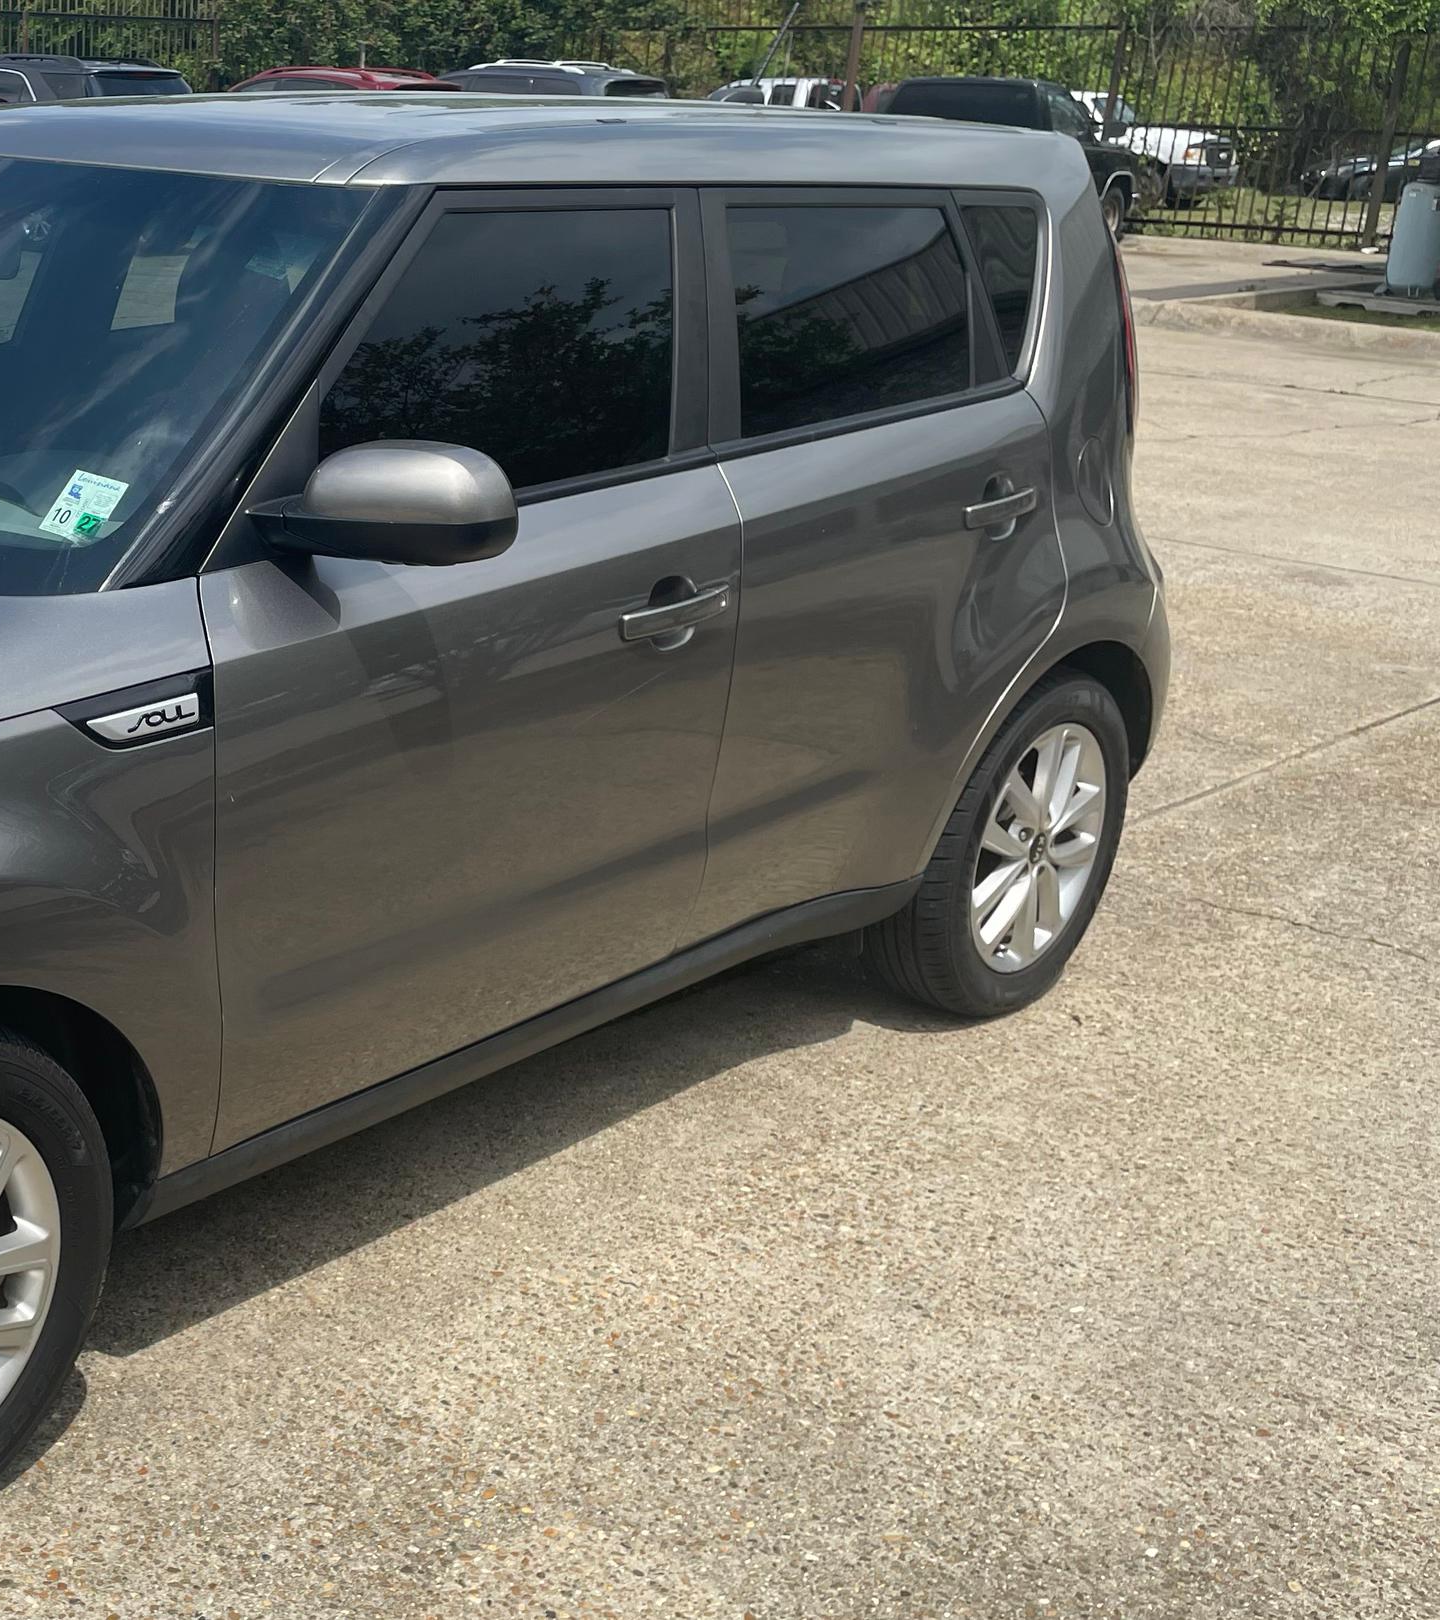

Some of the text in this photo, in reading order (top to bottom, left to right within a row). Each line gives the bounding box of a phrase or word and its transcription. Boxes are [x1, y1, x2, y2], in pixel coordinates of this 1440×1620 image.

[52, 507, 72, 524] 10
[76, 515, 101, 534] 27
[127, 705, 196, 734] SOUL
